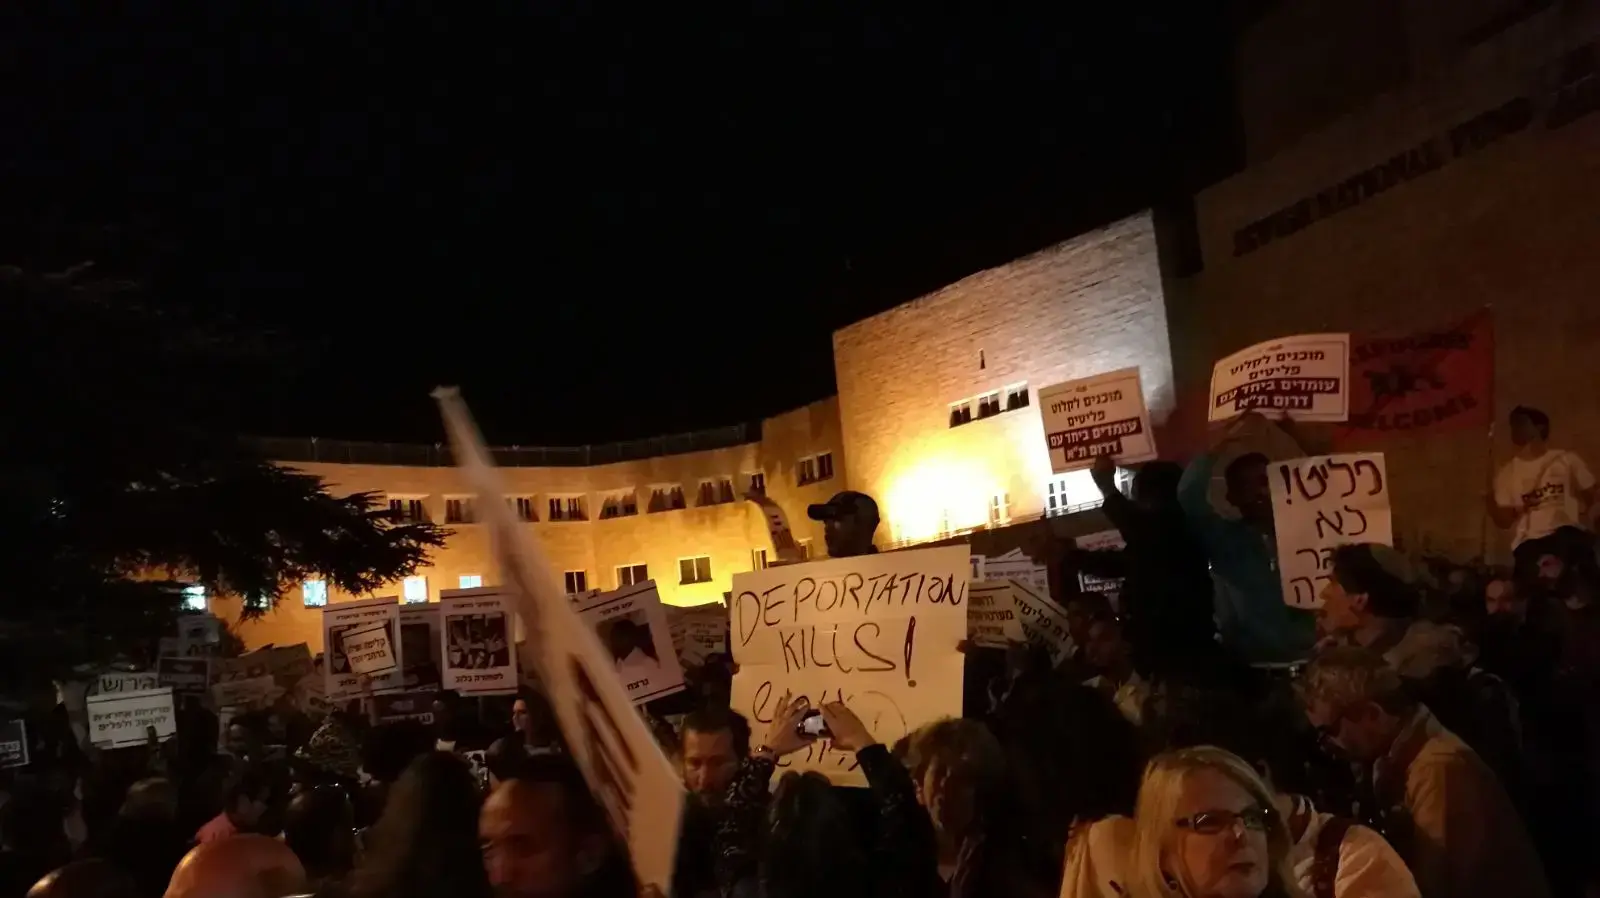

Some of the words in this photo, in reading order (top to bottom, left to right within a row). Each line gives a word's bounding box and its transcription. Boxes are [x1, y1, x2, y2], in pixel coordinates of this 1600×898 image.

[1229, 354, 1271, 376] לקלוט
[1275, 350, 1326, 363] מוכנים
[1247, 364, 1301, 380] פליטים
[1242, 381, 1278, 397] ביחד
[1279, 378, 1337, 393] עומדים
[1051, 397, 1081, 414] לקלוט
[1082, 388, 1123, 407] מוכנים
[1218, 389, 1238, 405] עם
[1274, 394, 1310, 408] דרום
[1067, 409, 1106, 427] פליטים
[1065, 428, 1090, 445] ביחד
[1092, 420, 1139, 439] עומדים
[1050, 434, 1065, 448] עם
[1090, 441, 1119, 456] דרום
[1279, 458, 1383, 505] פליט!
[1315, 505, 1368, 540] לא
[736, 572, 966, 646] DEPORTATION
